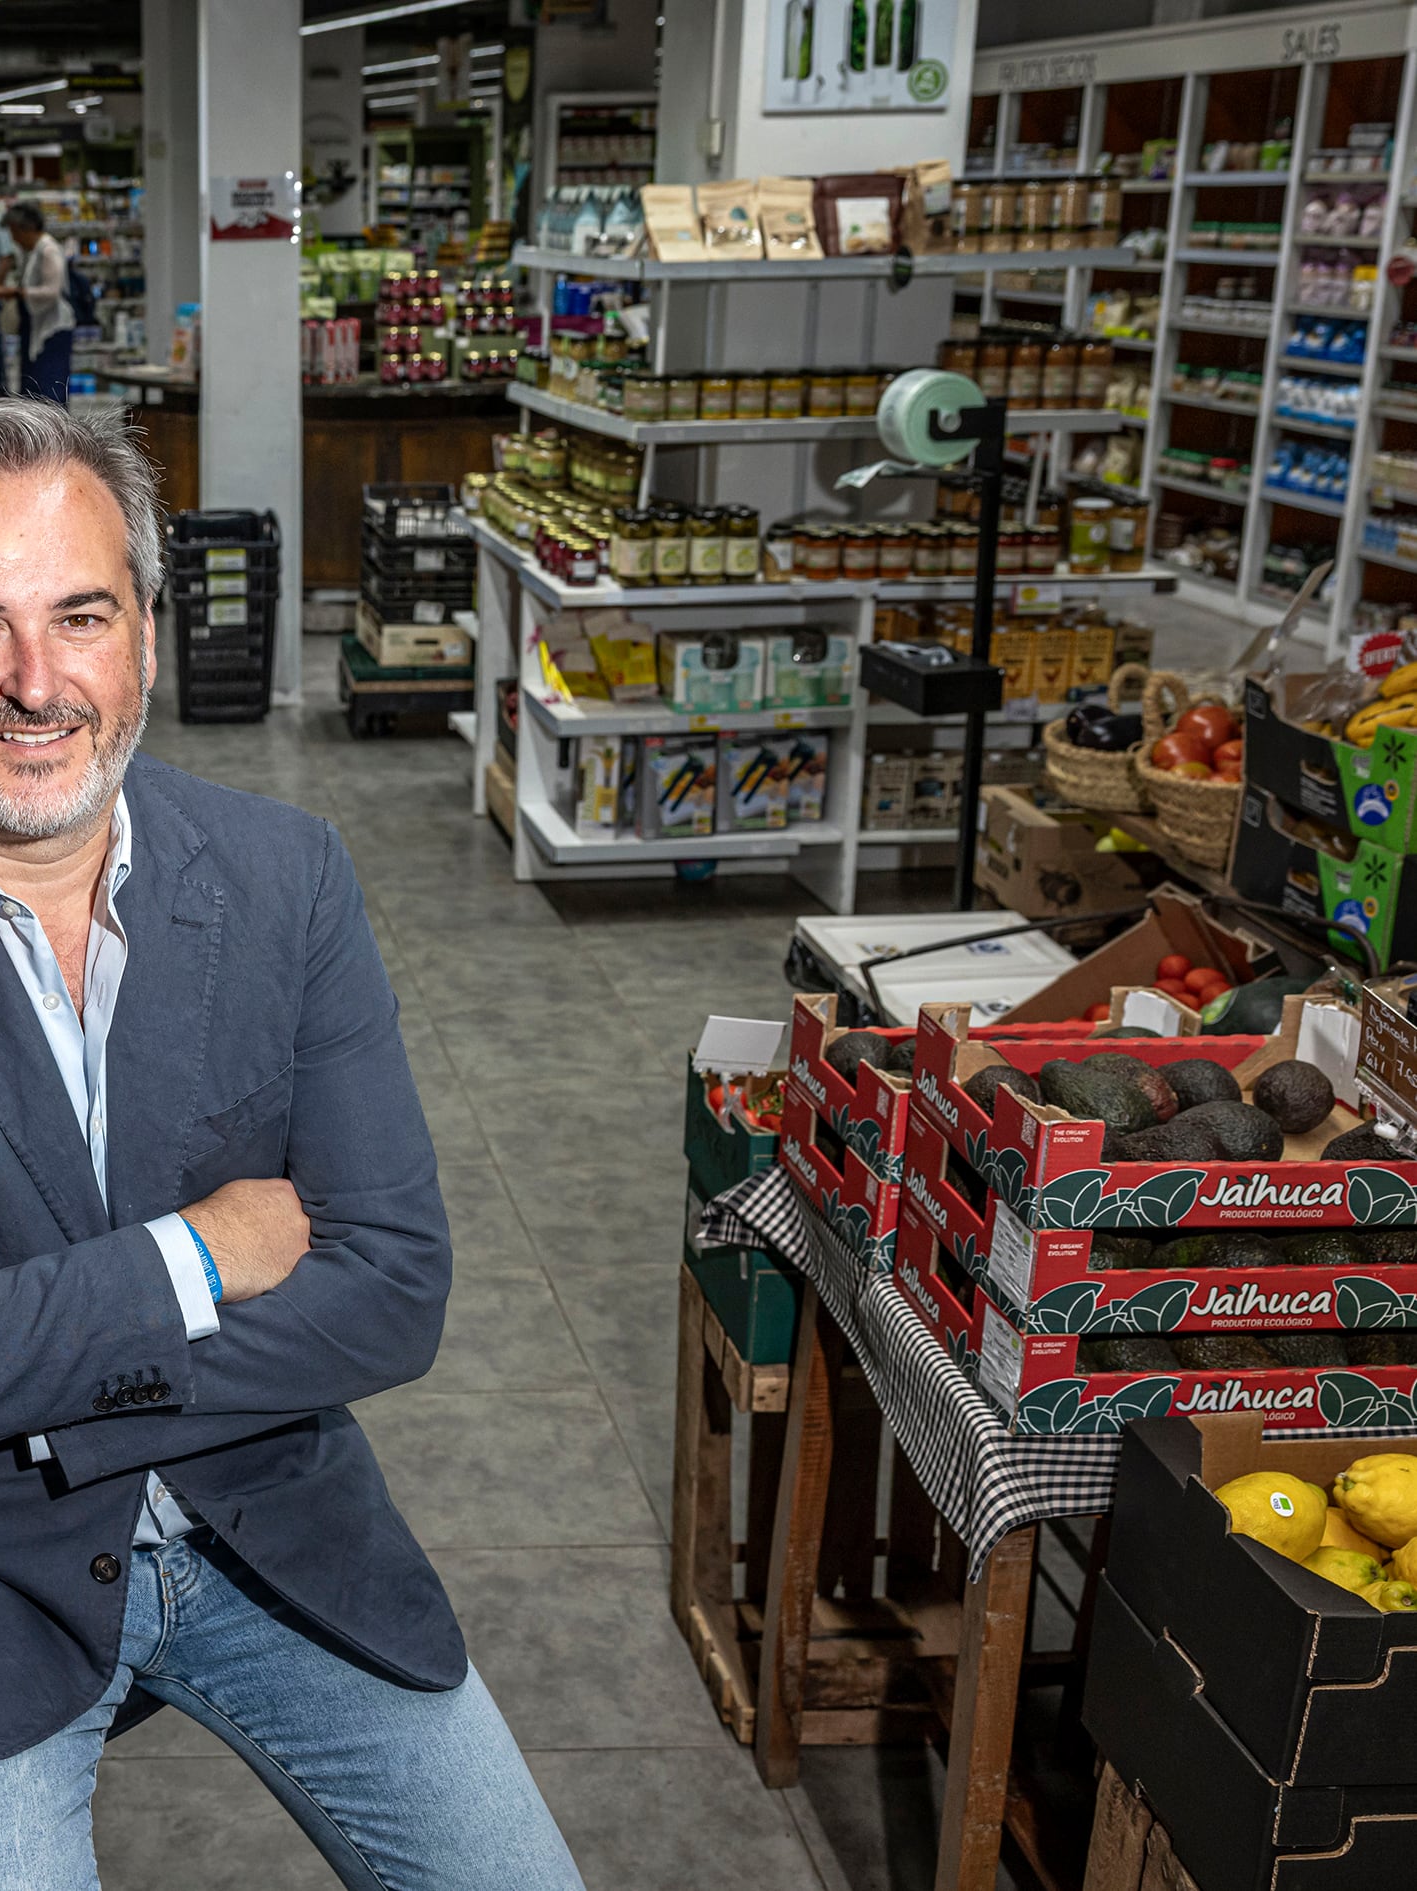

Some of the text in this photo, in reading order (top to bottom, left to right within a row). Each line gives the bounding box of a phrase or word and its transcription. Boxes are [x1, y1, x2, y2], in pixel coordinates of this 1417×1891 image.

[1364, 645, 1403, 669] OFERT
[1199, 1173, 1344, 1207] Jaihuca
[1219, 1208, 1324, 1219] PRODUCTOR ECOLÓGICO
[1190, 1282, 1332, 1317] Jaihuca
[1211, 1317, 1313, 1328] PRODUCTOR ECOLÓGICO
[1175, 1379, 1314, 1412] Jaihuca
[1264, 1410, 1296, 1421] LÓGICO
